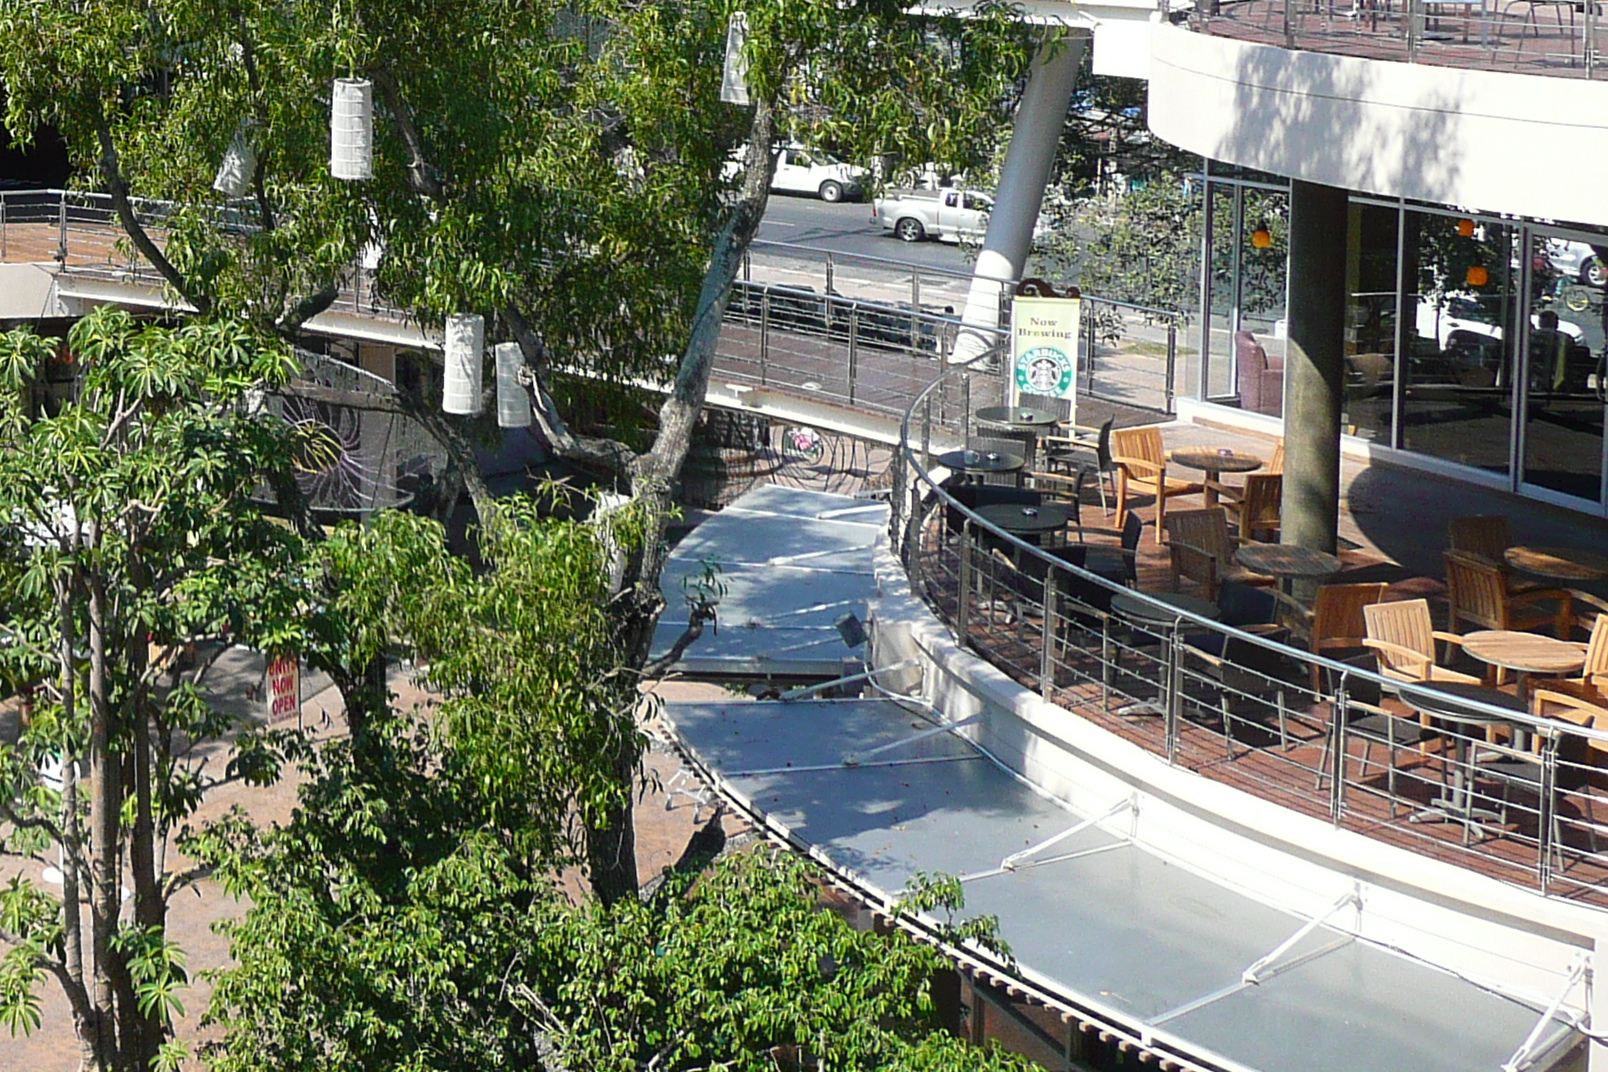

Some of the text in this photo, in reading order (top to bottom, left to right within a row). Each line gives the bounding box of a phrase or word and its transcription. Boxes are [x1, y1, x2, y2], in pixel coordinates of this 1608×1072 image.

[1029, 317, 1058, 326] Now
[1018, 327, 1073, 340] Brewing
[1017, 348, 1071, 374] STARBUCKS
[272, 675, 294, 697] NOW
[272, 694, 296, 716] OPEN
